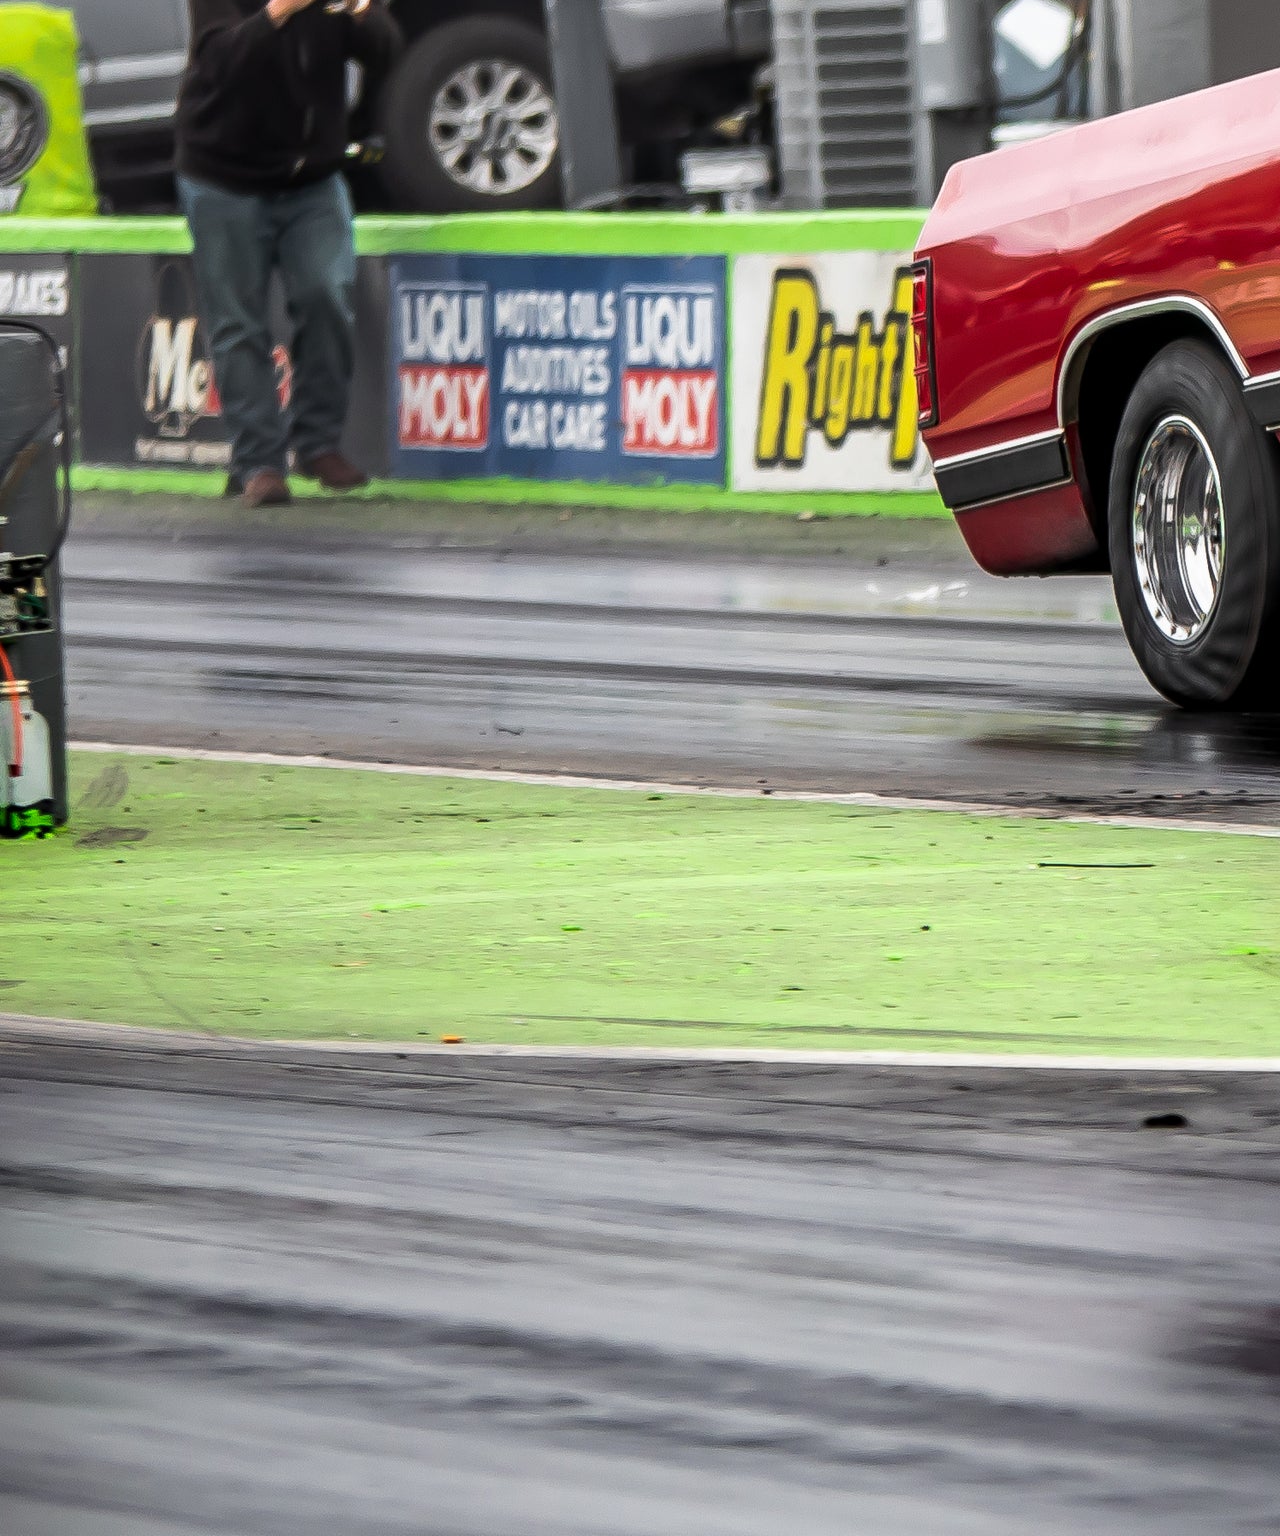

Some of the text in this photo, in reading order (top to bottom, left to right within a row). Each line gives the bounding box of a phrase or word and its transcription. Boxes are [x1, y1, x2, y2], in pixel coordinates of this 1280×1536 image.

[402, 293, 484, 362] LIQUI
[494, 290, 567, 339] MOTOR
[625, 296, 713, 368] LIQUI
[400, 372, 488, 440] MOLY
[504, 400, 607, 451] CAR CARE
[624, 376, 716, 446] MOLY
